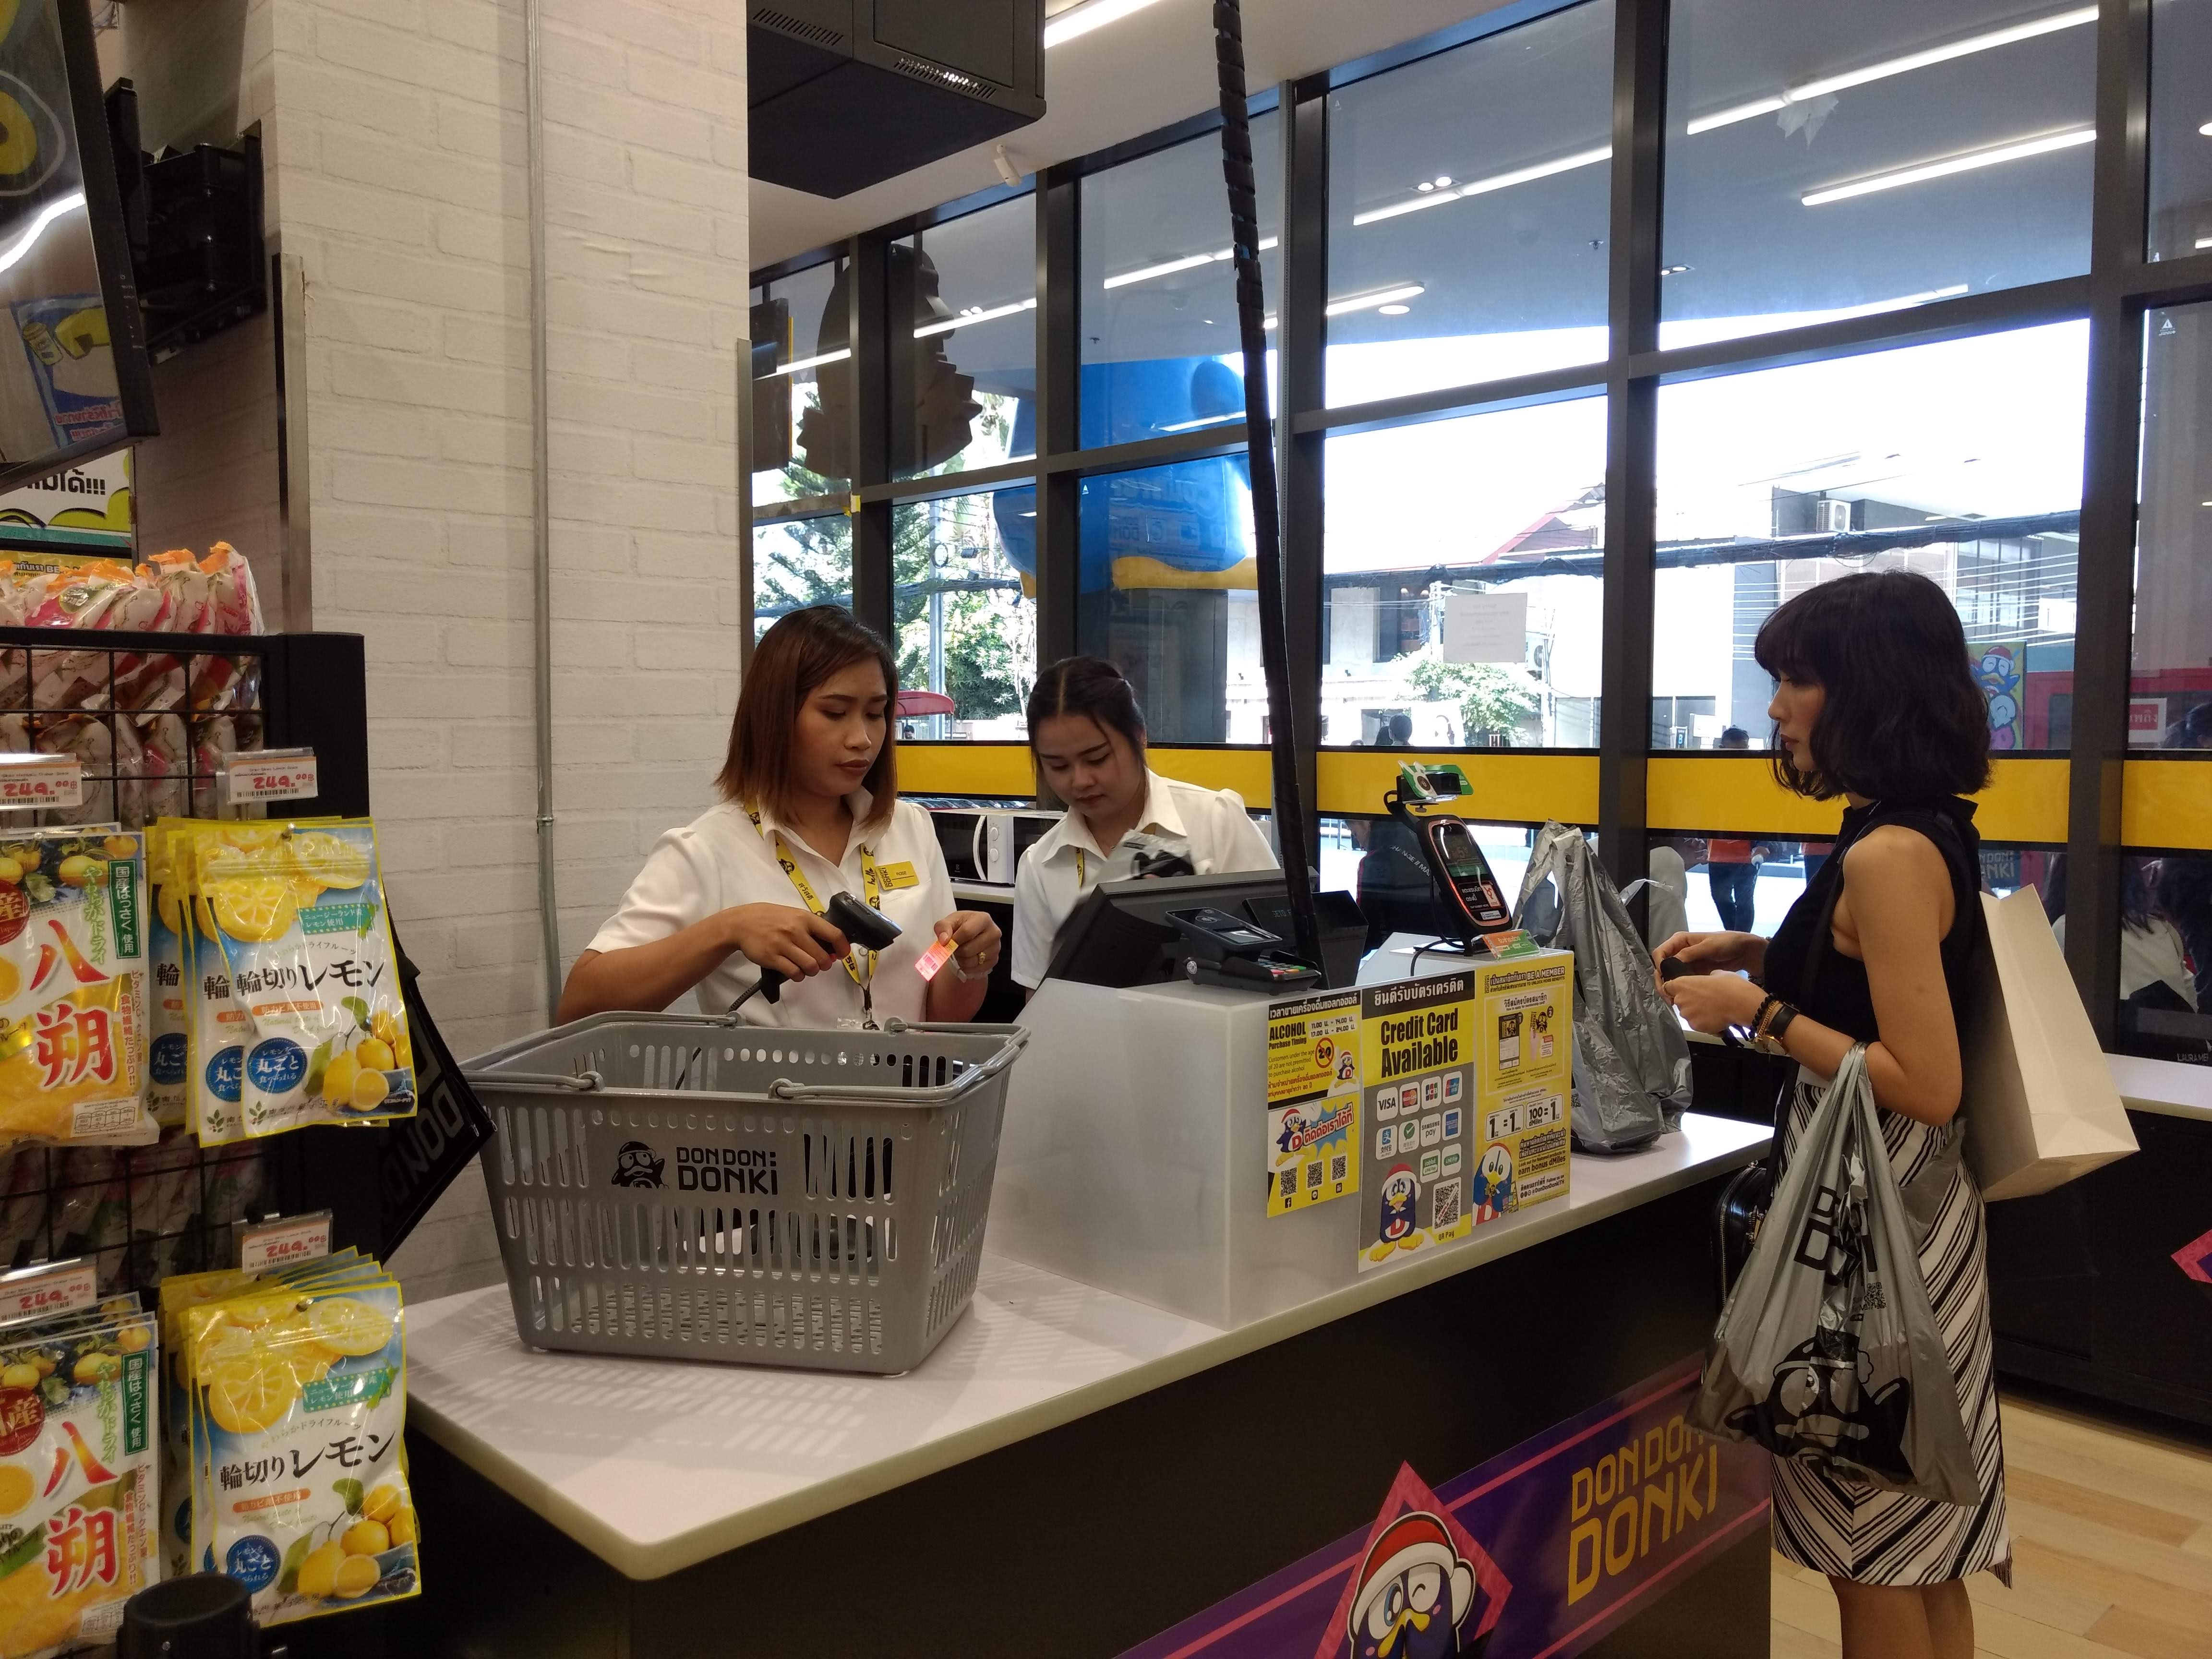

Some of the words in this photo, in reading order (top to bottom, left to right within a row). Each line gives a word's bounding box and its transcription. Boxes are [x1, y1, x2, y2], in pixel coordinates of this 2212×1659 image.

[236, 960, 385, 997] 輪切りレモン
[1527, 971, 1535, 981] BE
[1536, 971, 1541, 979] A
[1541, 967, 1565, 978] MEMBER
[1374, 978, 1464, 1006] ยินดีรับบัตรเครดิต
[1269, 1022, 1306, 1041] ALCOHOL
[1381, 1015, 1424, 1046] Credit
[1427, 1008, 1458, 1036] Card
[1269, 1041, 1291, 1050] Purchase
[1292, 1037, 1307, 1046] Timing
[154, 1051, 188, 1066] 丸ご
[1381, 1035, 1458, 1079] Available
[1378, 1097, 1396, 1110] VISA
[1529, 1106, 1543, 1119] 100
[1421, 1121, 1440, 1130] SAMSUNG
[1529, 1118, 1543, 1127] dMiles
[1426, 1129, 1436, 1138] pay
[1518, 1166, 1530, 1175] earn
[1531, 1161, 1548, 1171] bonus
[1549, 1155, 1565, 1166] dMiles
[677, 1165, 778, 1195] DONKI
[1445, 1230, 1455, 1238] Pay
[219, 1431, 396, 1491] 輪切りレモン
[1571, 1439, 1639, 1523] DON
[1568, 1444, 1719, 1607] DONKI
